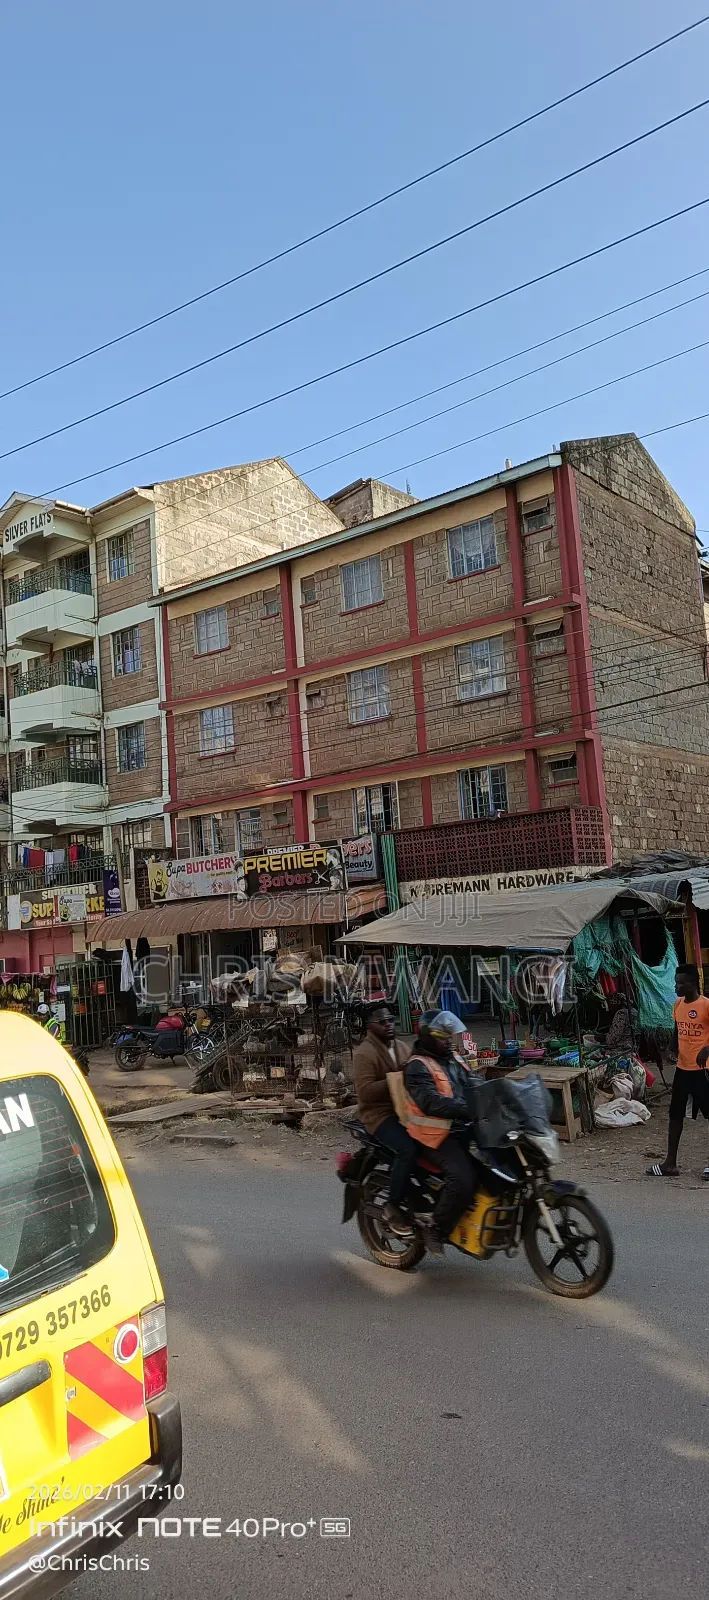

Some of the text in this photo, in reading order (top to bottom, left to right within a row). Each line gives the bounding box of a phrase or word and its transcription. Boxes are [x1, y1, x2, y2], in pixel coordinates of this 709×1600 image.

[5, 512, 52, 542] SILVER FLATS
[166, 861, 187, 878] Supa
[244, 849, 328, 875] PREMIER
[259, 872, 313, 893] Barbers
[497, 871, 574, 890] HARDWARE
[0, 1284, 111, 1360] 729 357366
